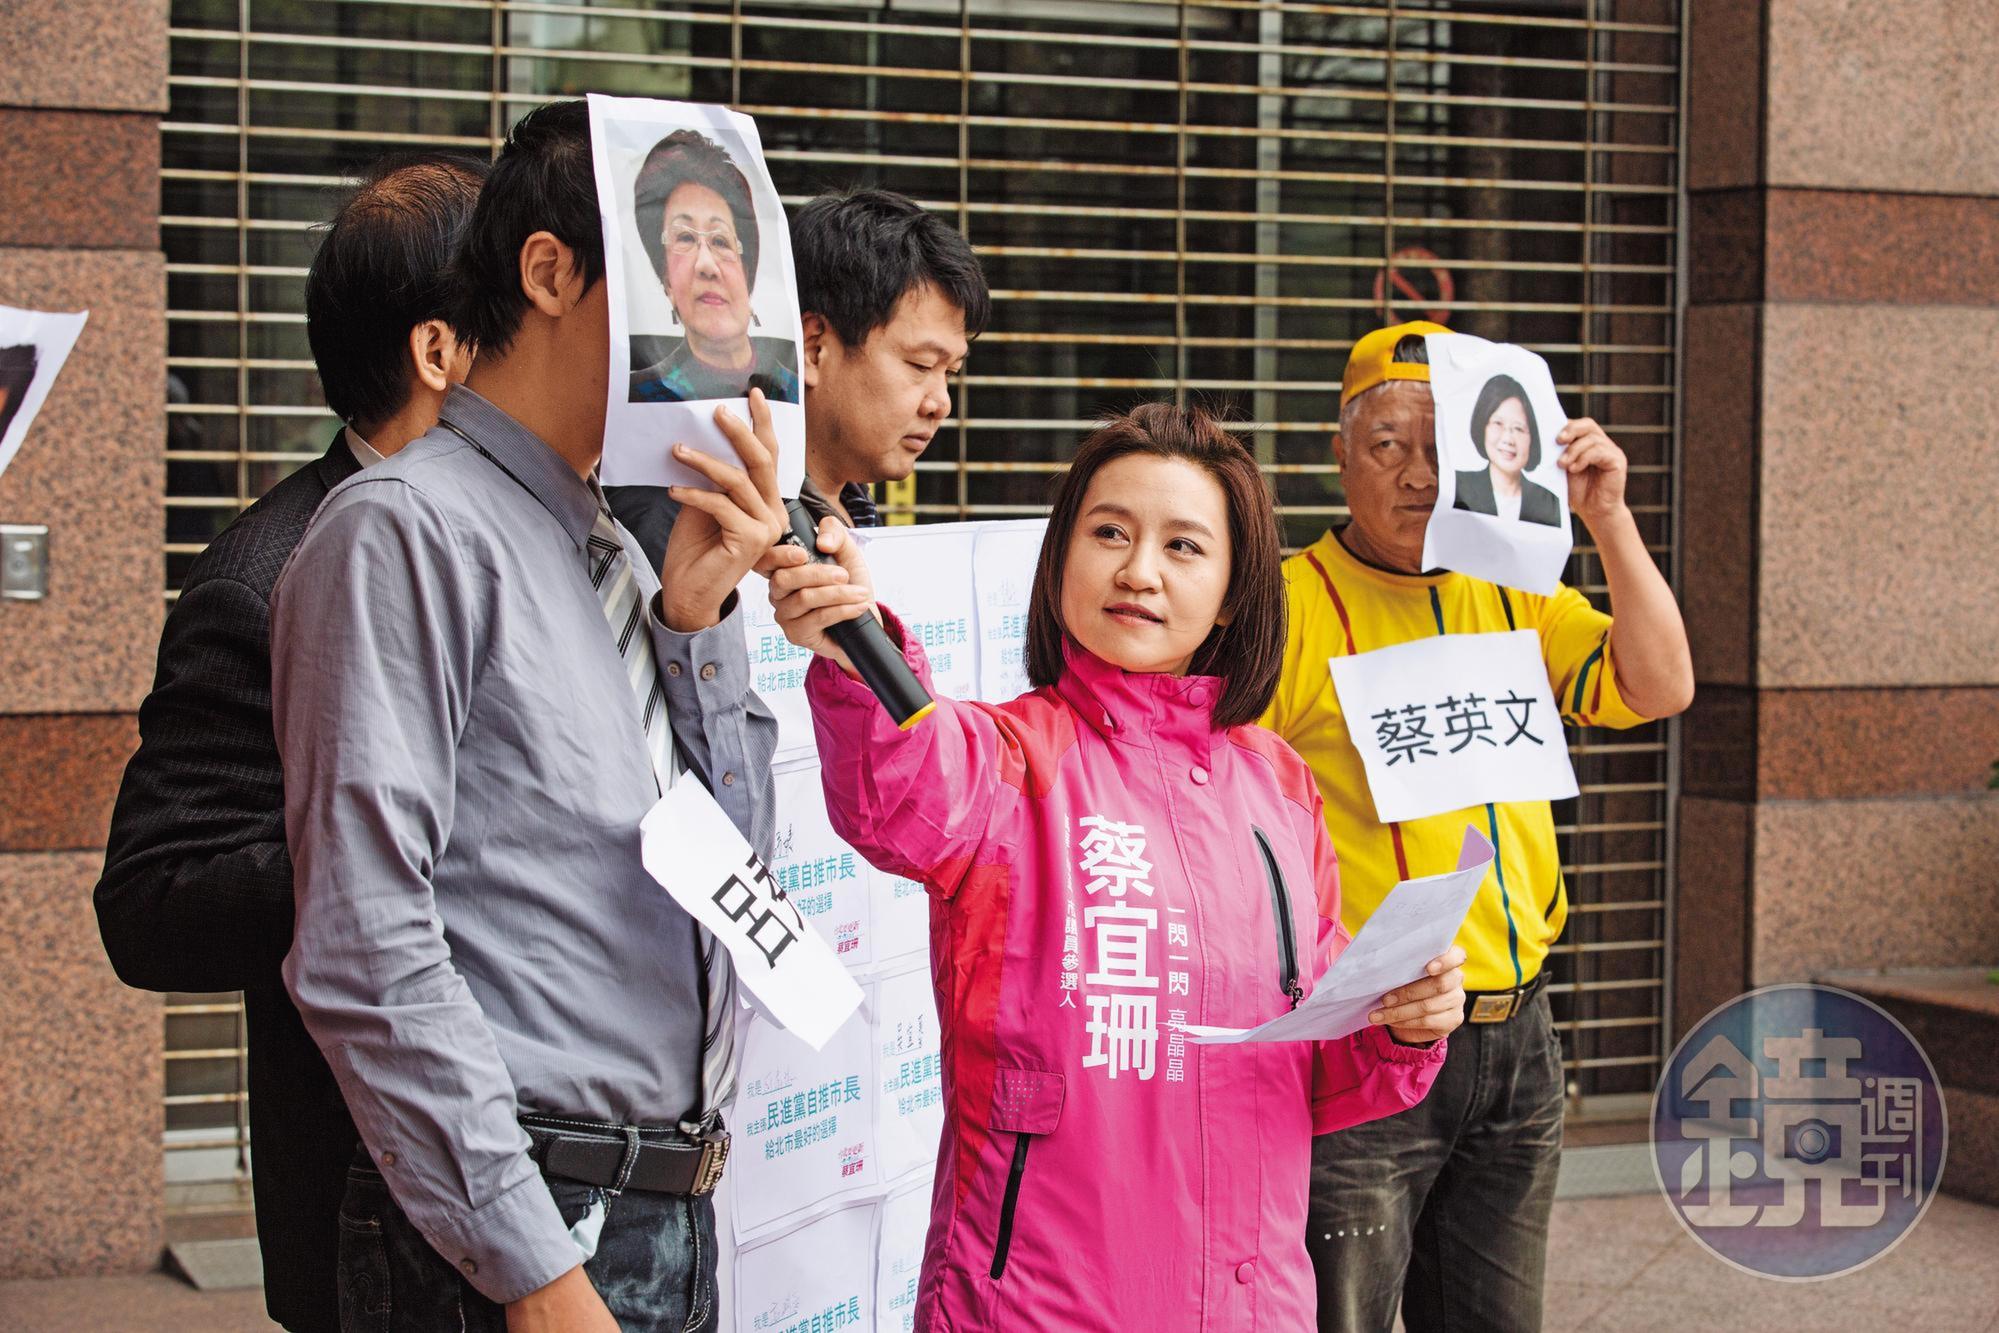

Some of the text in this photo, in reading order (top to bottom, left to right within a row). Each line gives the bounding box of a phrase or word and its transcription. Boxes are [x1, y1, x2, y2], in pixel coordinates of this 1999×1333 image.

[1371, 689, 1544, 767] 蔡英文
[1079, 813, 1160, 1081] 蔡宜珊
[1167, 906, 1189, 996] 一閃一閃
